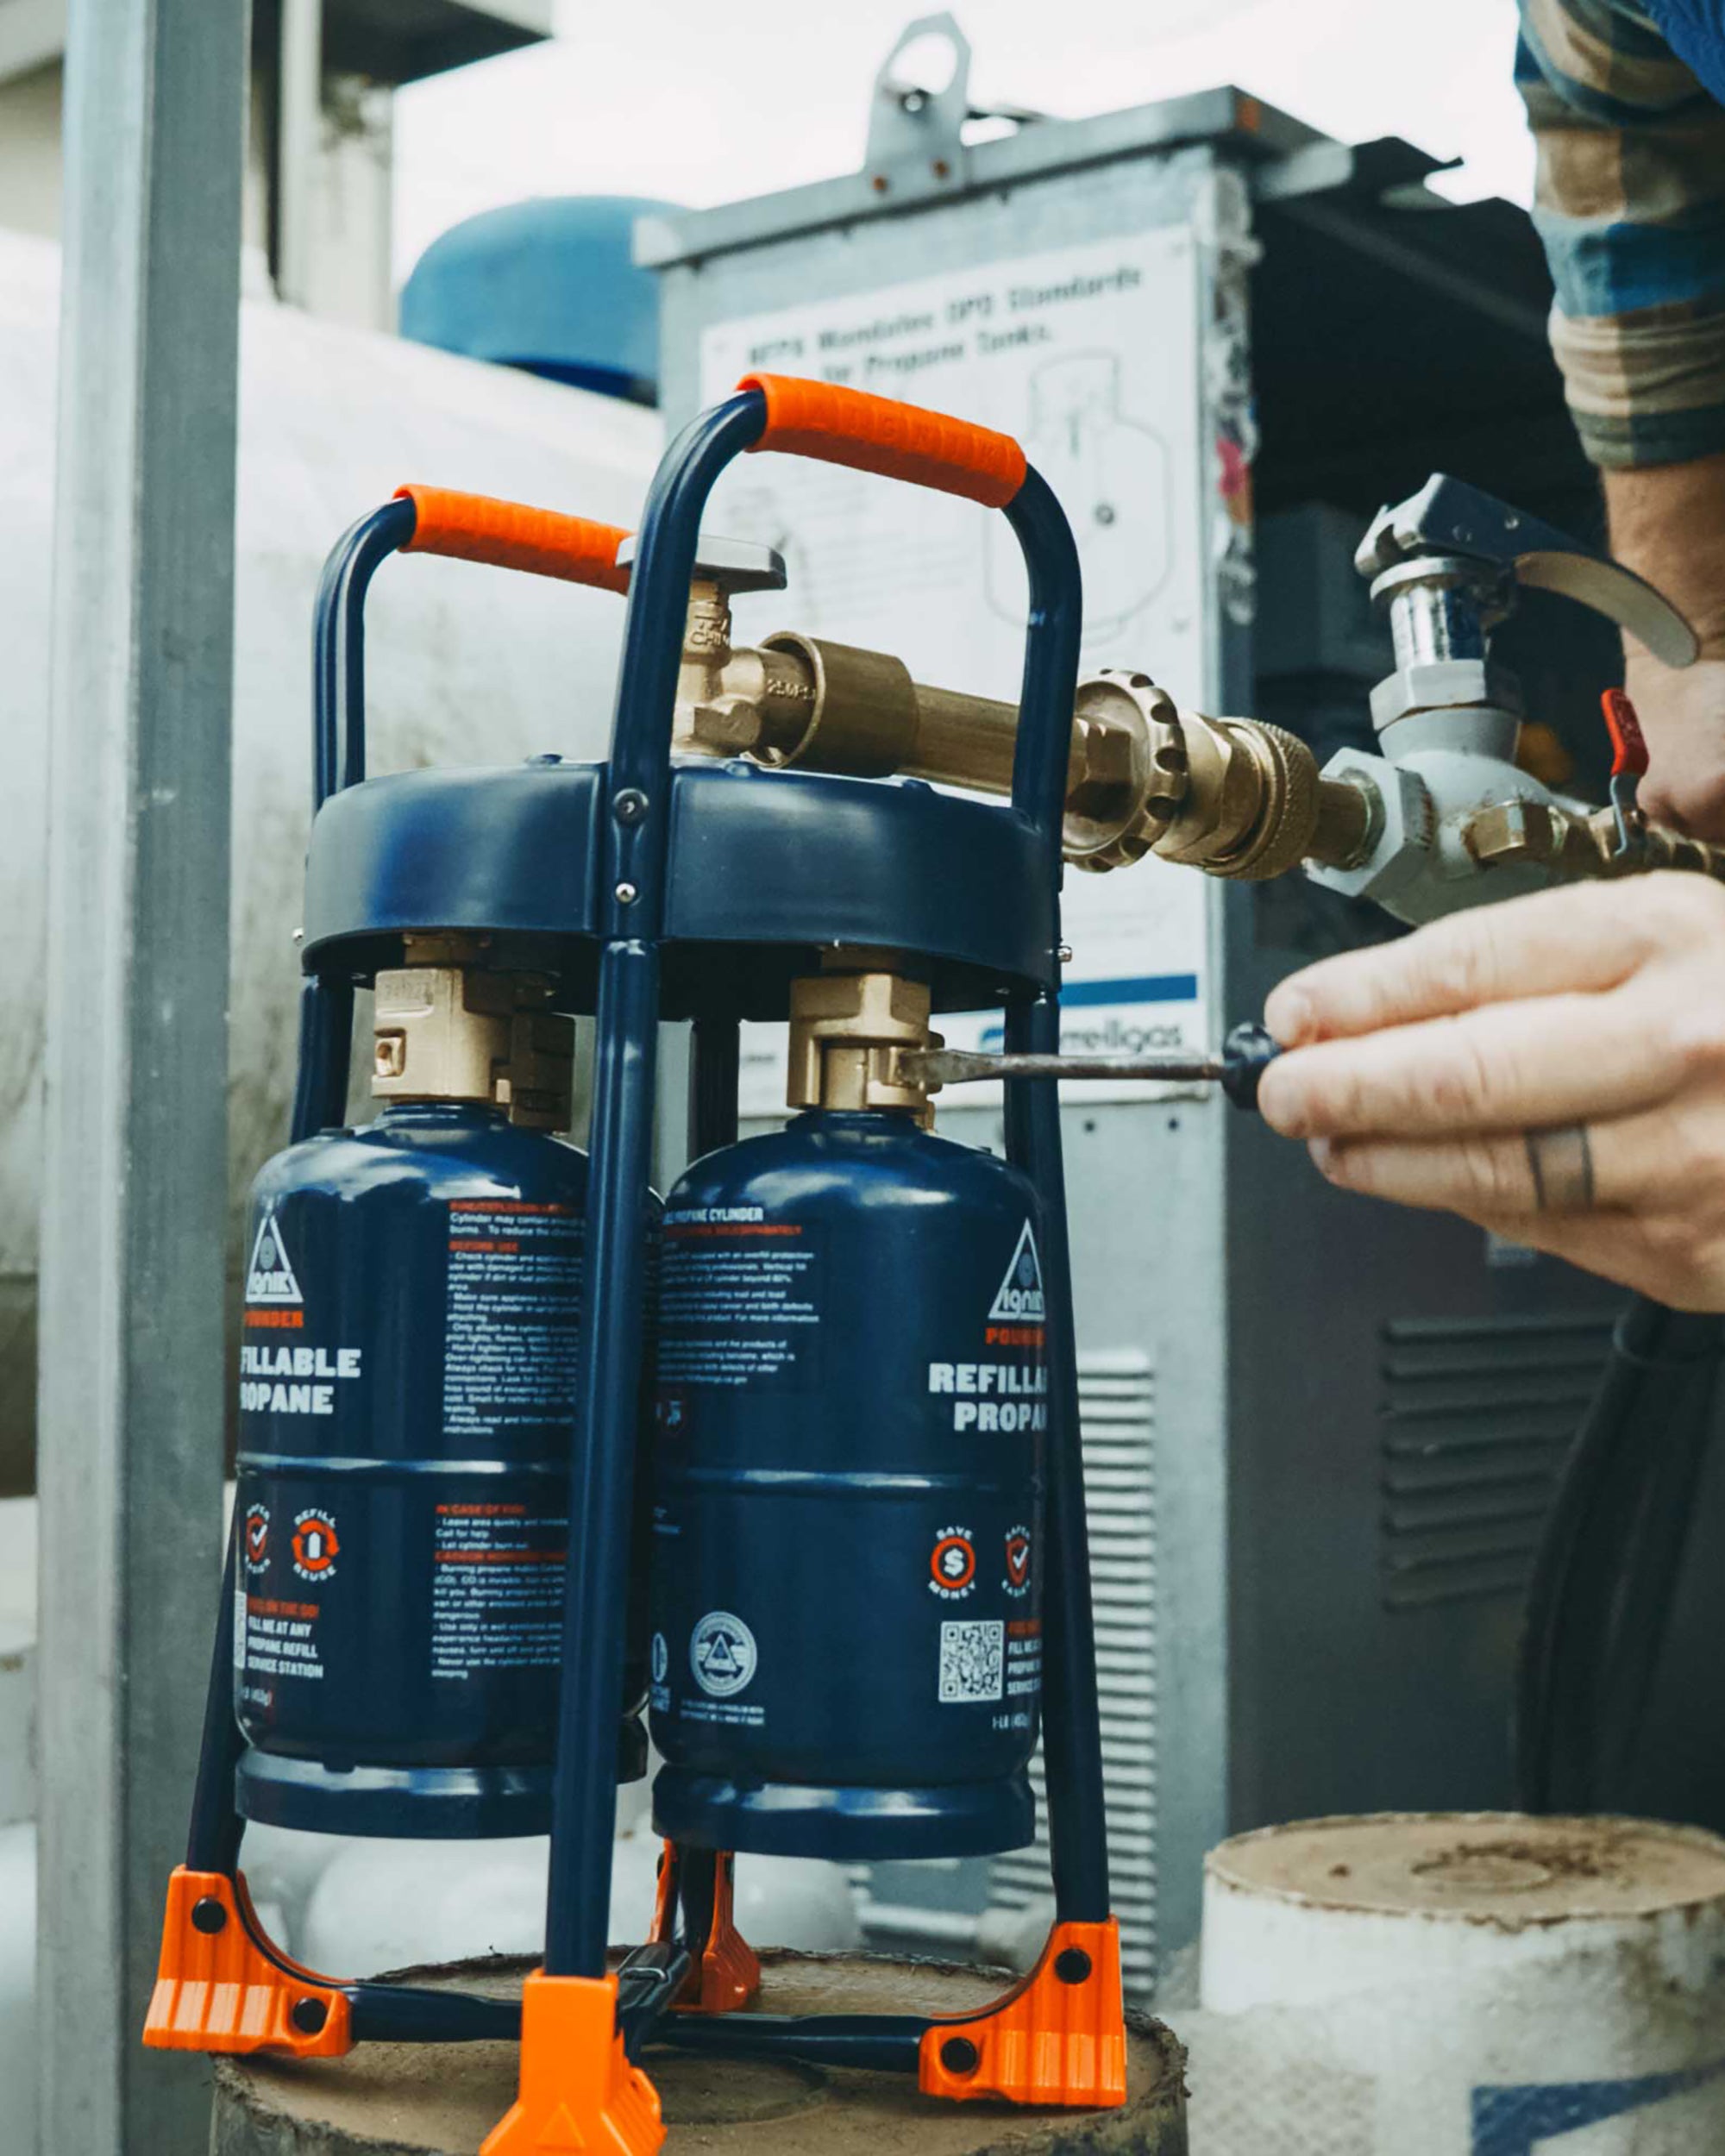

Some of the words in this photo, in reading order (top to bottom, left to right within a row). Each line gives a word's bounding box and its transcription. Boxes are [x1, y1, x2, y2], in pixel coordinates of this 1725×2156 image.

[817, 311, 934, 352] Mandates
[1007, 266, 1143, 311] Standards
[864, 342, 965, 376] Propane
[450, 1213, 492, 1224] Cylinder
[708, 1206, 764, 1222] CYLINDER
[502, 1225, 533, 1235] reduce
[455, 1252, 482, 1261] Check
[485, 1253, 517, 1263] cylinder
[487, 1264, 524, 1273] damaged
[448, 1274, 483, 1283] cylinder
[452, 1324, 473, 1332] Only
[475, 1324, 501, 1332] attach
[242, 1346, 361, 1377] FILLABLE
[445, 1363, 476, 1373] Always
[928, 1362, 1047, 1395] REFILLA
[241, 1382, 335, 1414] ROPANE
[449, 1414, 480, 1424] Always
[954, 1401, 1047, 1432] PROPA
[294, 1507, 336, 1529] REFILL
[436, 1529, 454, 1538] Call
[455, 1529, 467, 1538] for
[936, 1526, 973, 1541] SAVE
[458, 1541, 492, 1551] cylinder
[441, 1564, 475, 1574] Burning
[279, 1659, 324, 1679] STATION
